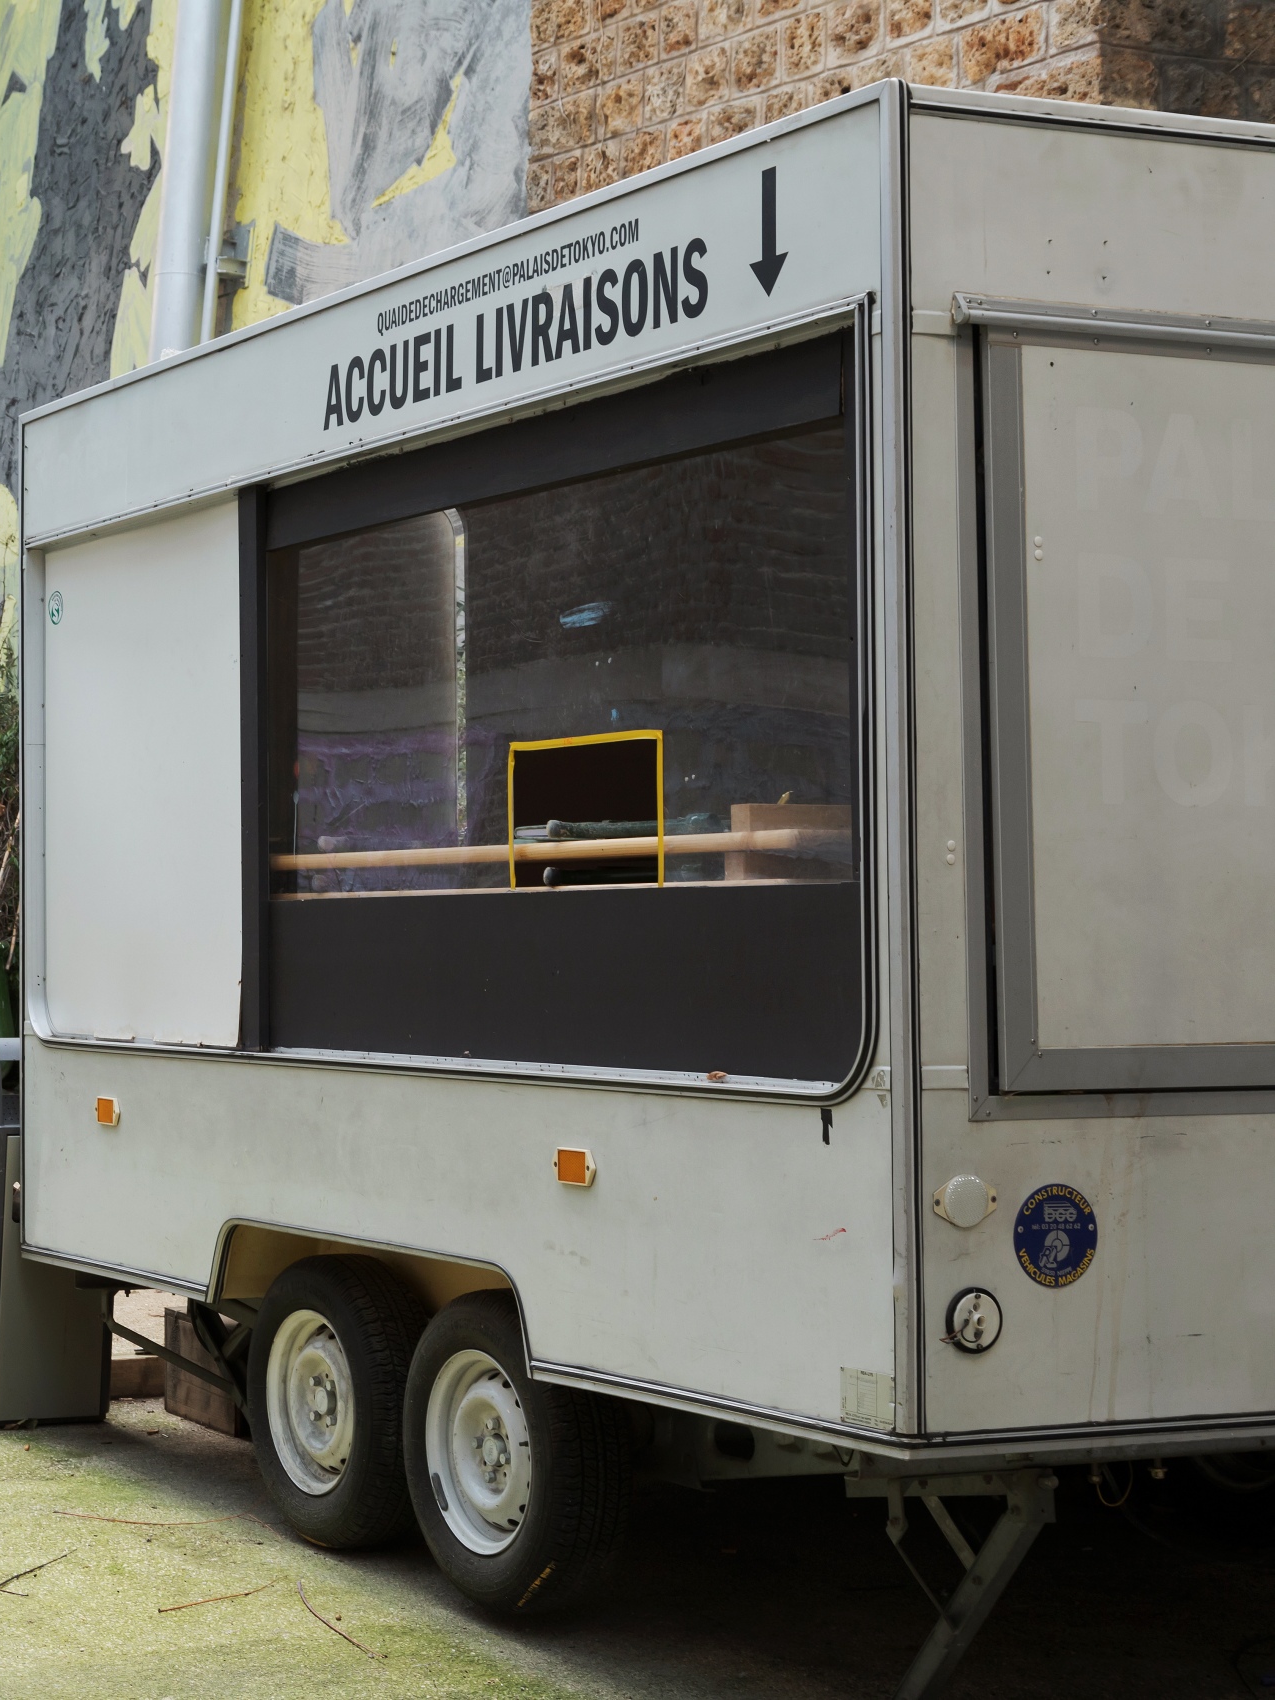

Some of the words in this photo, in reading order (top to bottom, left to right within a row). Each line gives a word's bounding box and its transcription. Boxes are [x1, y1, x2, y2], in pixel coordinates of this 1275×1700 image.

[377, 218, 639, 336] QUAIDEDECHARGEMENT@PALAISDETOKYO.COM
[323, 323, 462, 431] ACCUEIL
[475, 237, 709, 384] LIVRAISONS
[1077, 551, 1231, 662] DE
[1023, 1186, 1092, 1215] CONSTRUCTEUR
[1019, 1248, 1055, 1286] VEHICULES
[1058, 1248, 1095, 1286] MAGASINS
